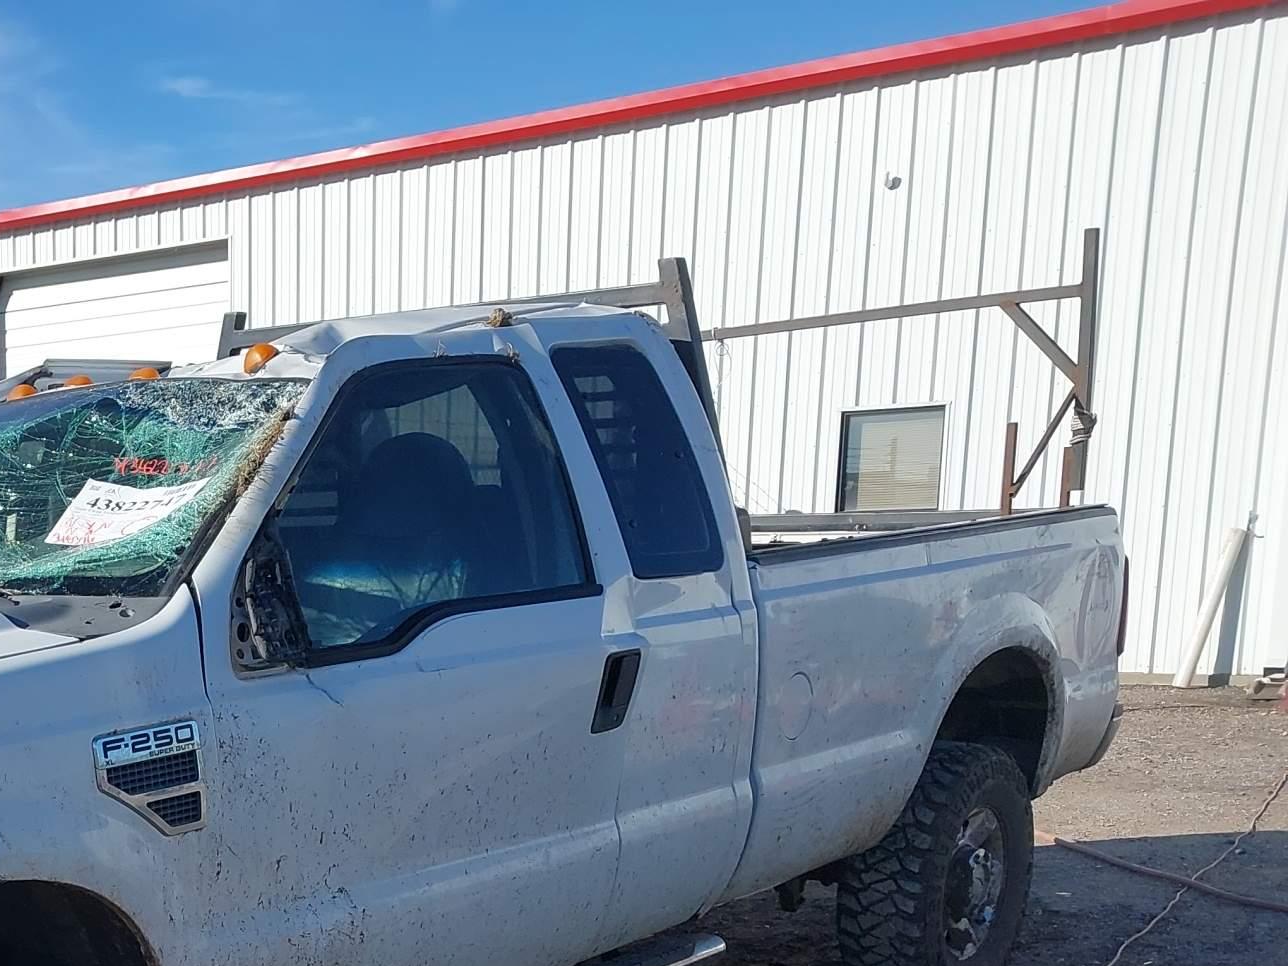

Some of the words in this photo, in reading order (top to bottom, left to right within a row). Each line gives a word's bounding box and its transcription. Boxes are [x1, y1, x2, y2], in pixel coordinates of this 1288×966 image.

[86, 493, 187, 512] 43822747
[148, 747, 174, 758] SUPER
[175, 742, 197, 753] DUTY
